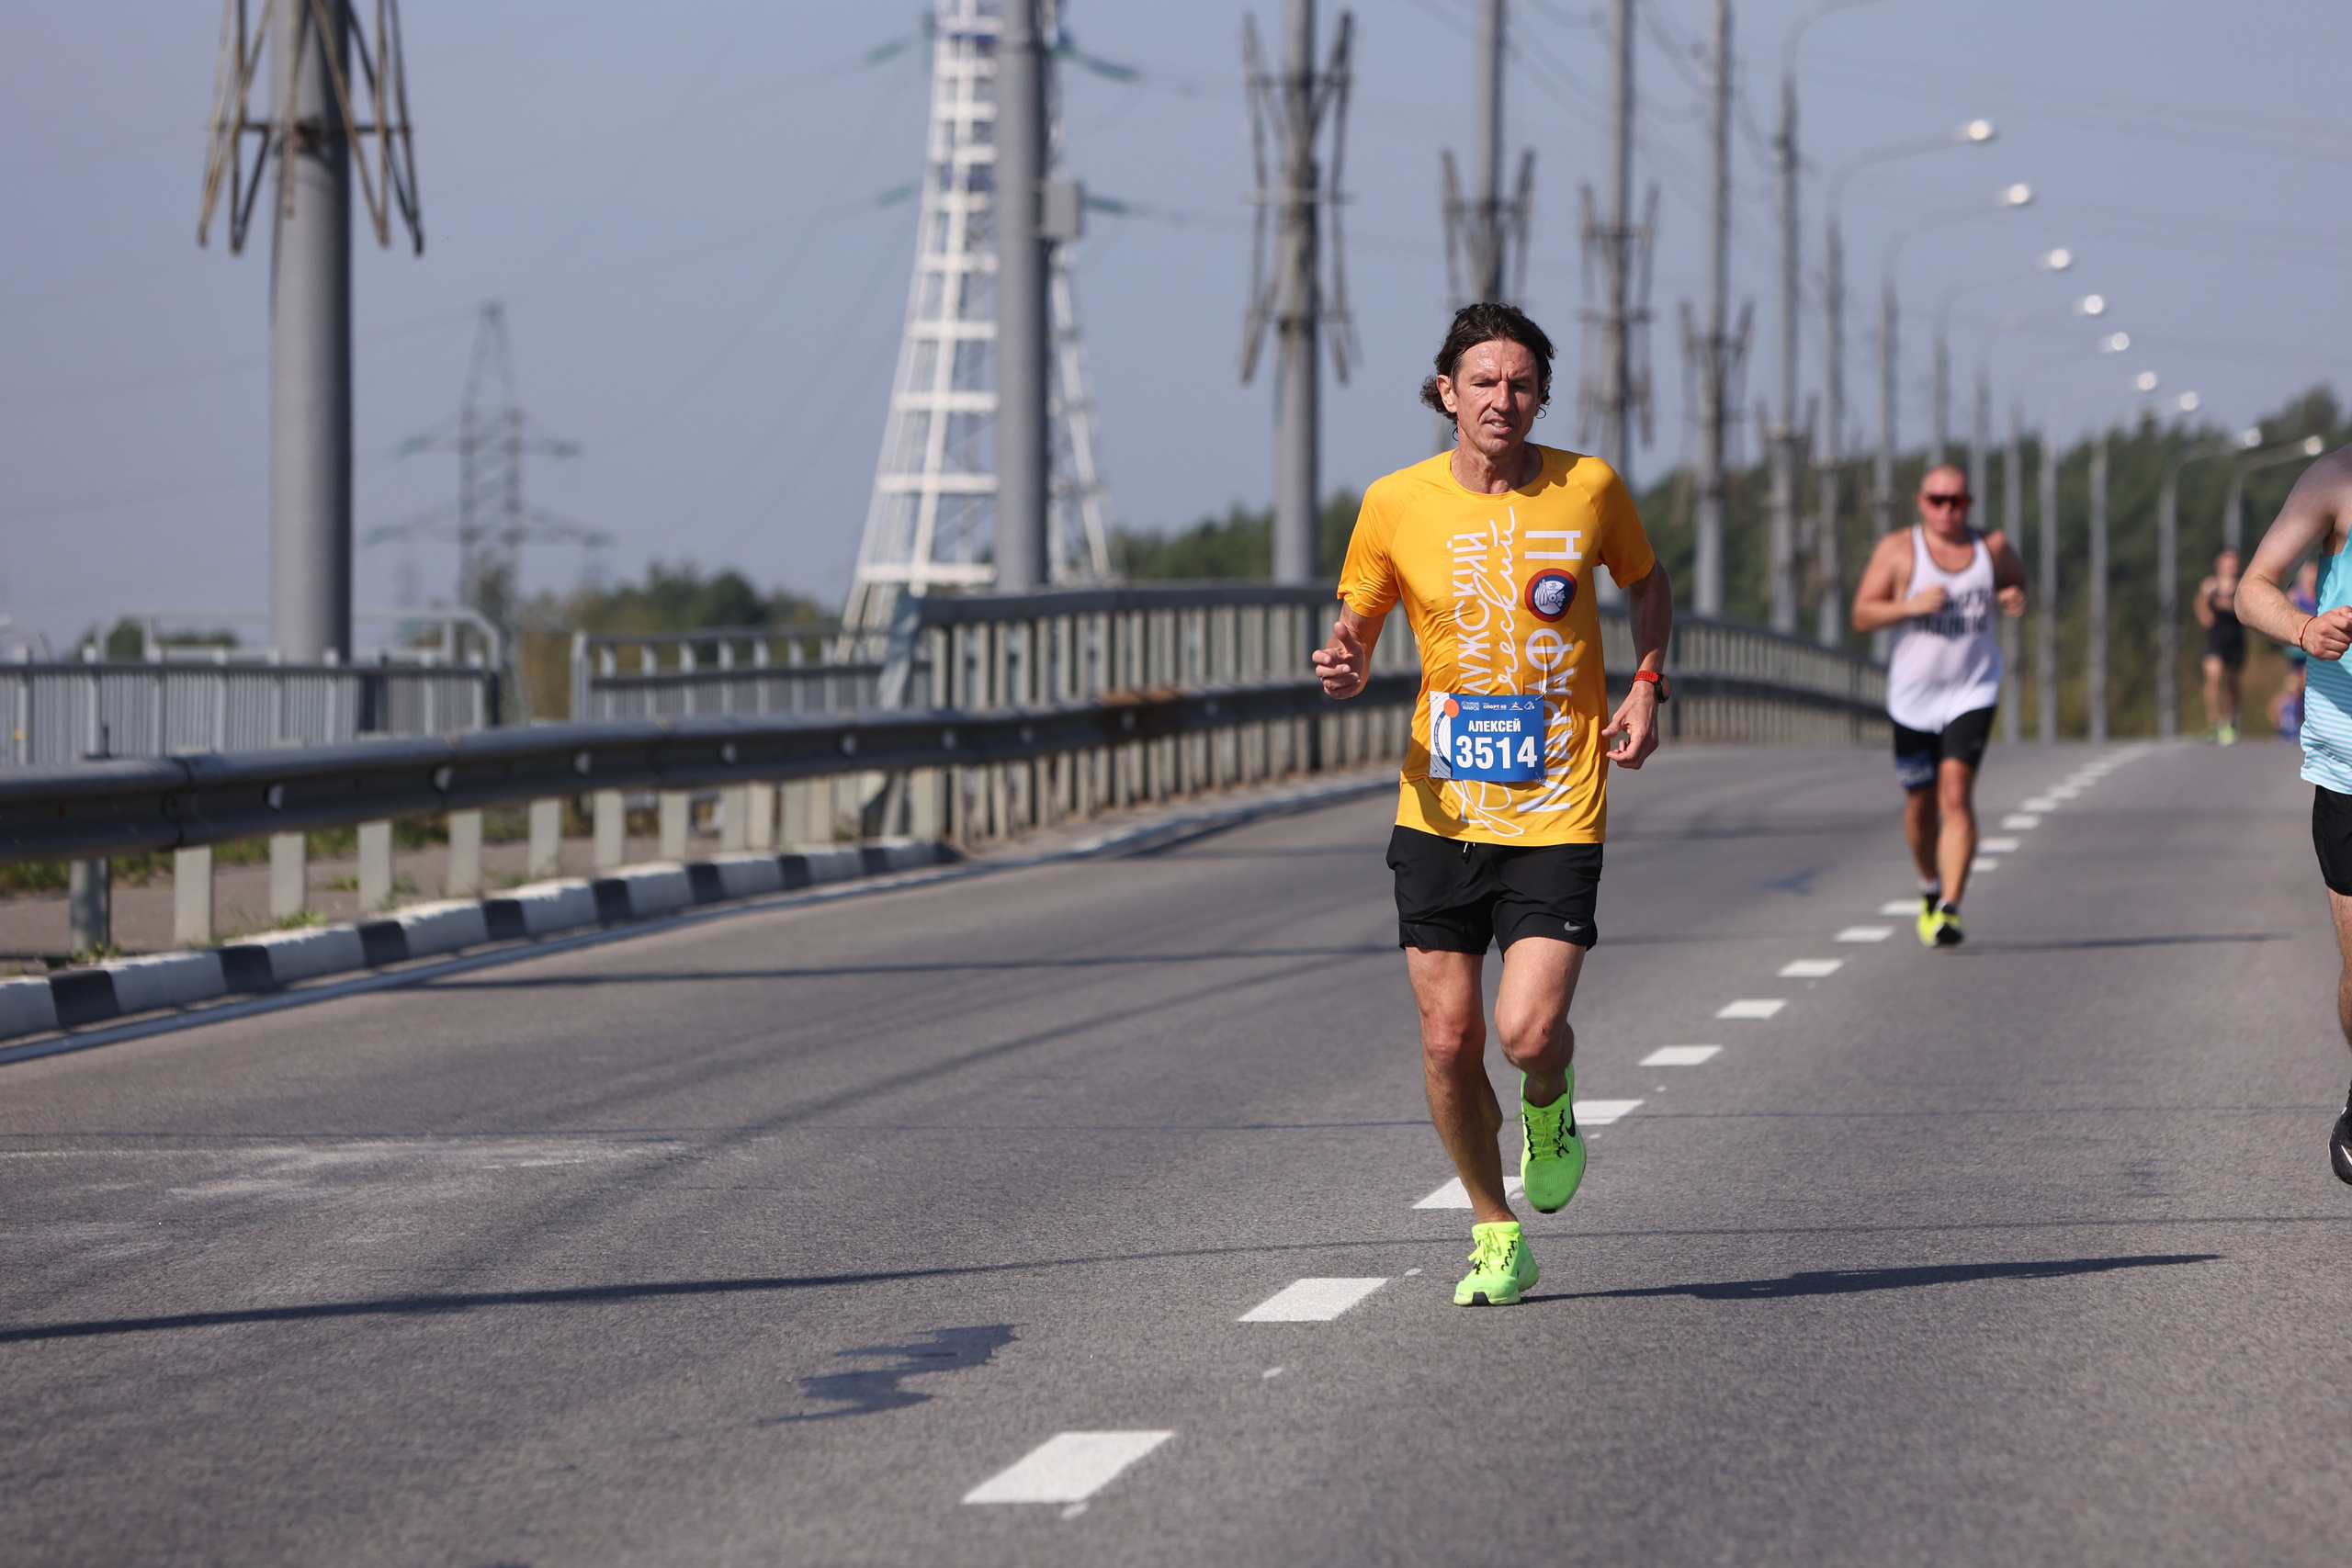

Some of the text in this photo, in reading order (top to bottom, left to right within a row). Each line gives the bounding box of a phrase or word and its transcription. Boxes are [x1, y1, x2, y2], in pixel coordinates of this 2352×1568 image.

[1447, 532, 1492, 695] ЛУЖСКИЙ
[1468, 718, 1521, 732] АЛЕКСЕЙ
[1455, 735, 1538, 769] 3514
